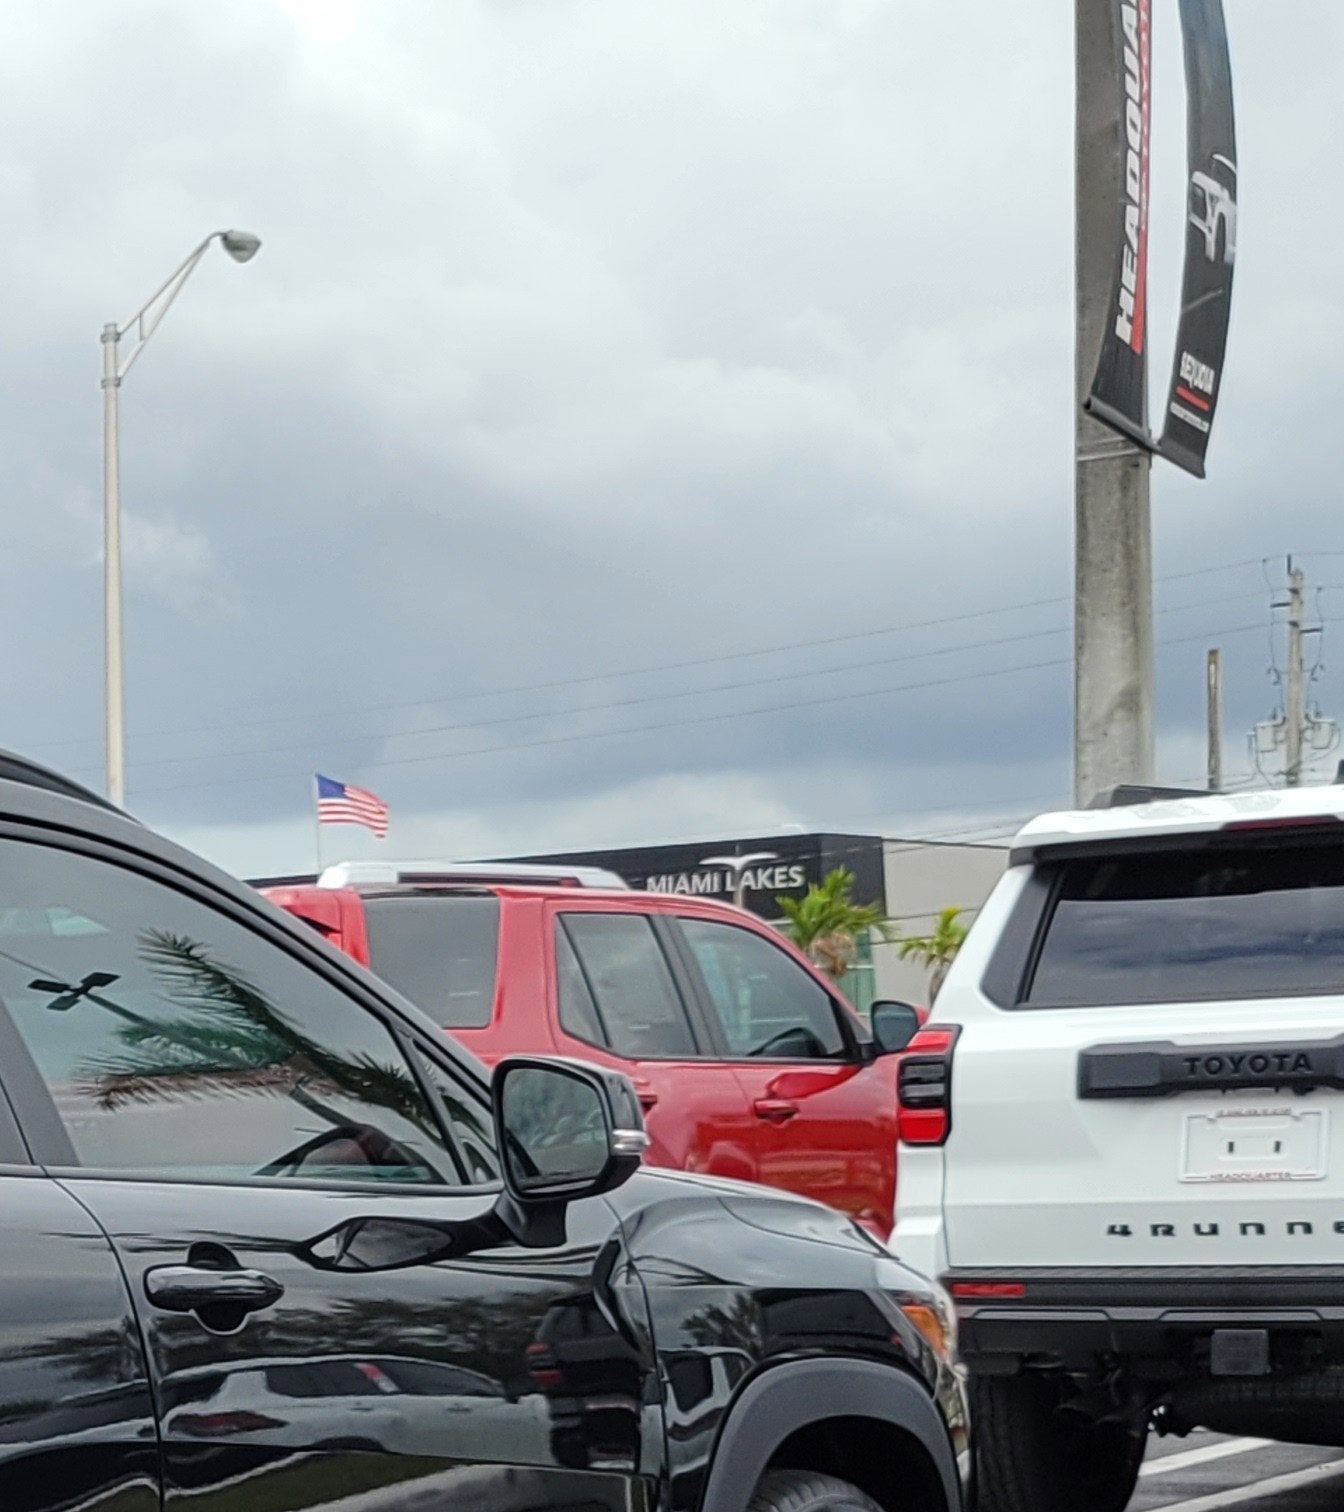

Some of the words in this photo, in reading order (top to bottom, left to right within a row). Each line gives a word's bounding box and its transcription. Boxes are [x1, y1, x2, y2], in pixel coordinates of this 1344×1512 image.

[1115, 0, 1141, 346] HEADQUA
[646, 871, 720, 894] MIAMI
[725, 866, 806, 892] LAKES
[1184, 1053, 1313, 1077] TOYOTA
